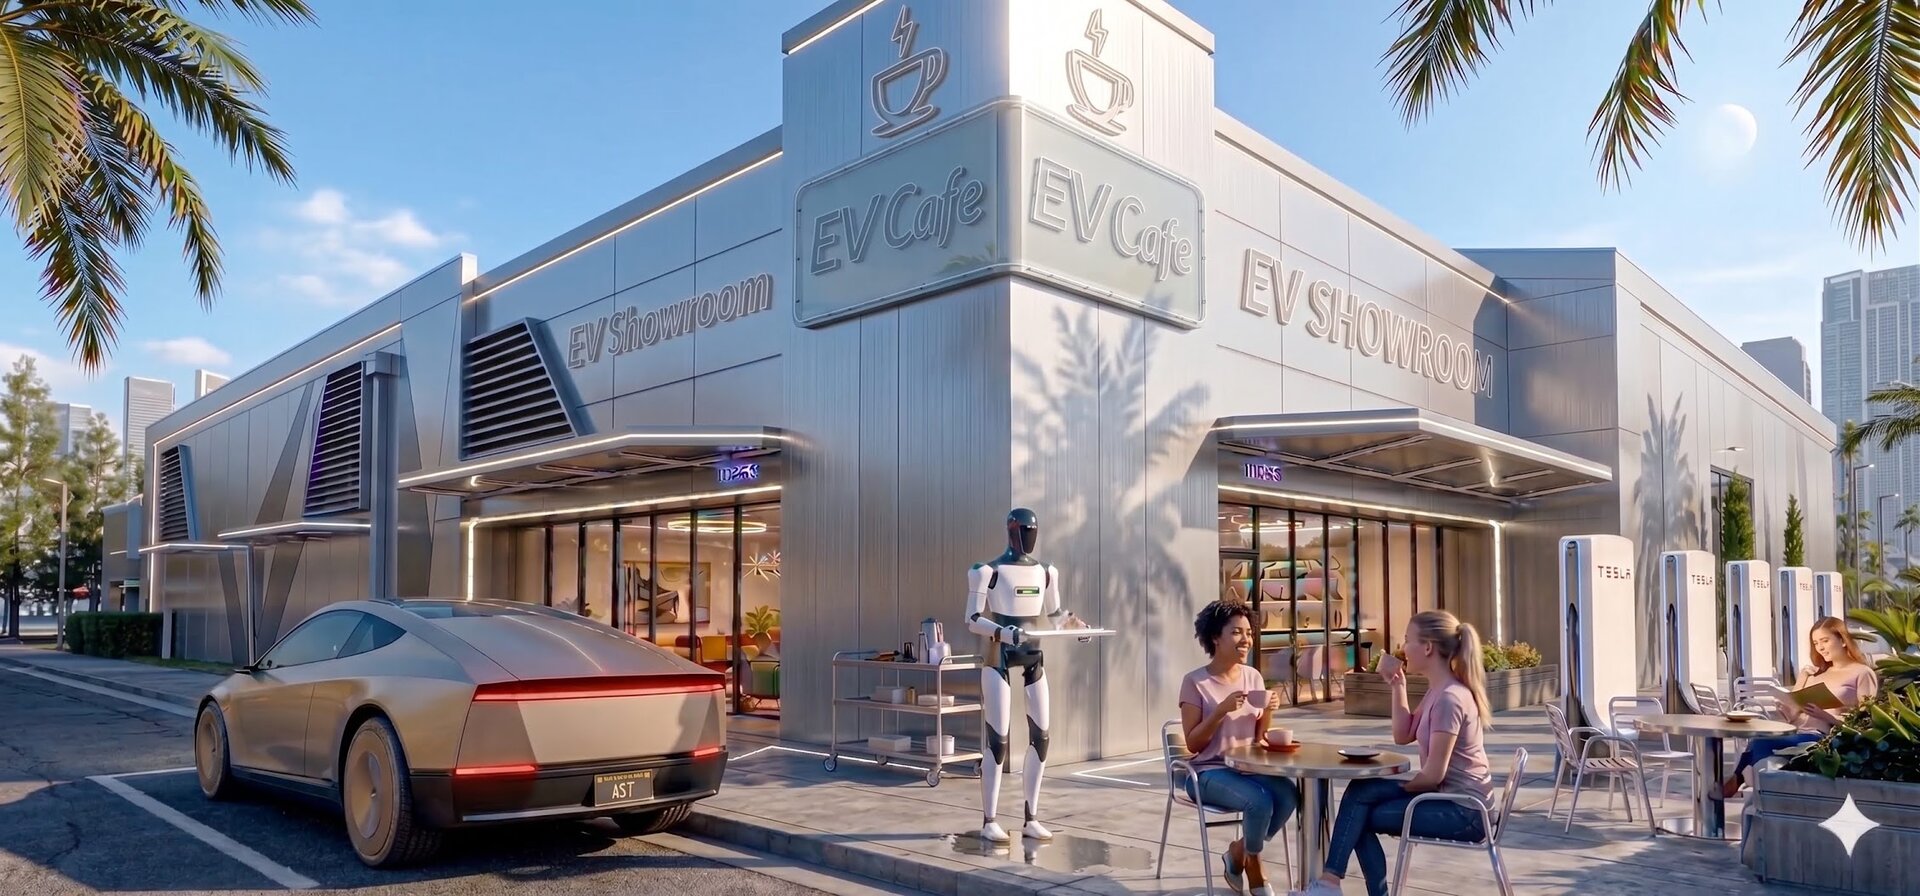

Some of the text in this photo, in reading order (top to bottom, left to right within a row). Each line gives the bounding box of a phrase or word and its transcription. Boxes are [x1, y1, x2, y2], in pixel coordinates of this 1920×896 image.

[810, 165, 985, 276] EV Cafe
[1030, 156, 1192, 282] EV Cafe
[566, 272, 774, 369] EV Showroom
[1241, 248, 1493, 399] EV SHOWROOM
[1597, 565, 1631, 580] TESLA
[1691, 574, 1713, 586] TESLA
[612, 781, 635, 799] AST
